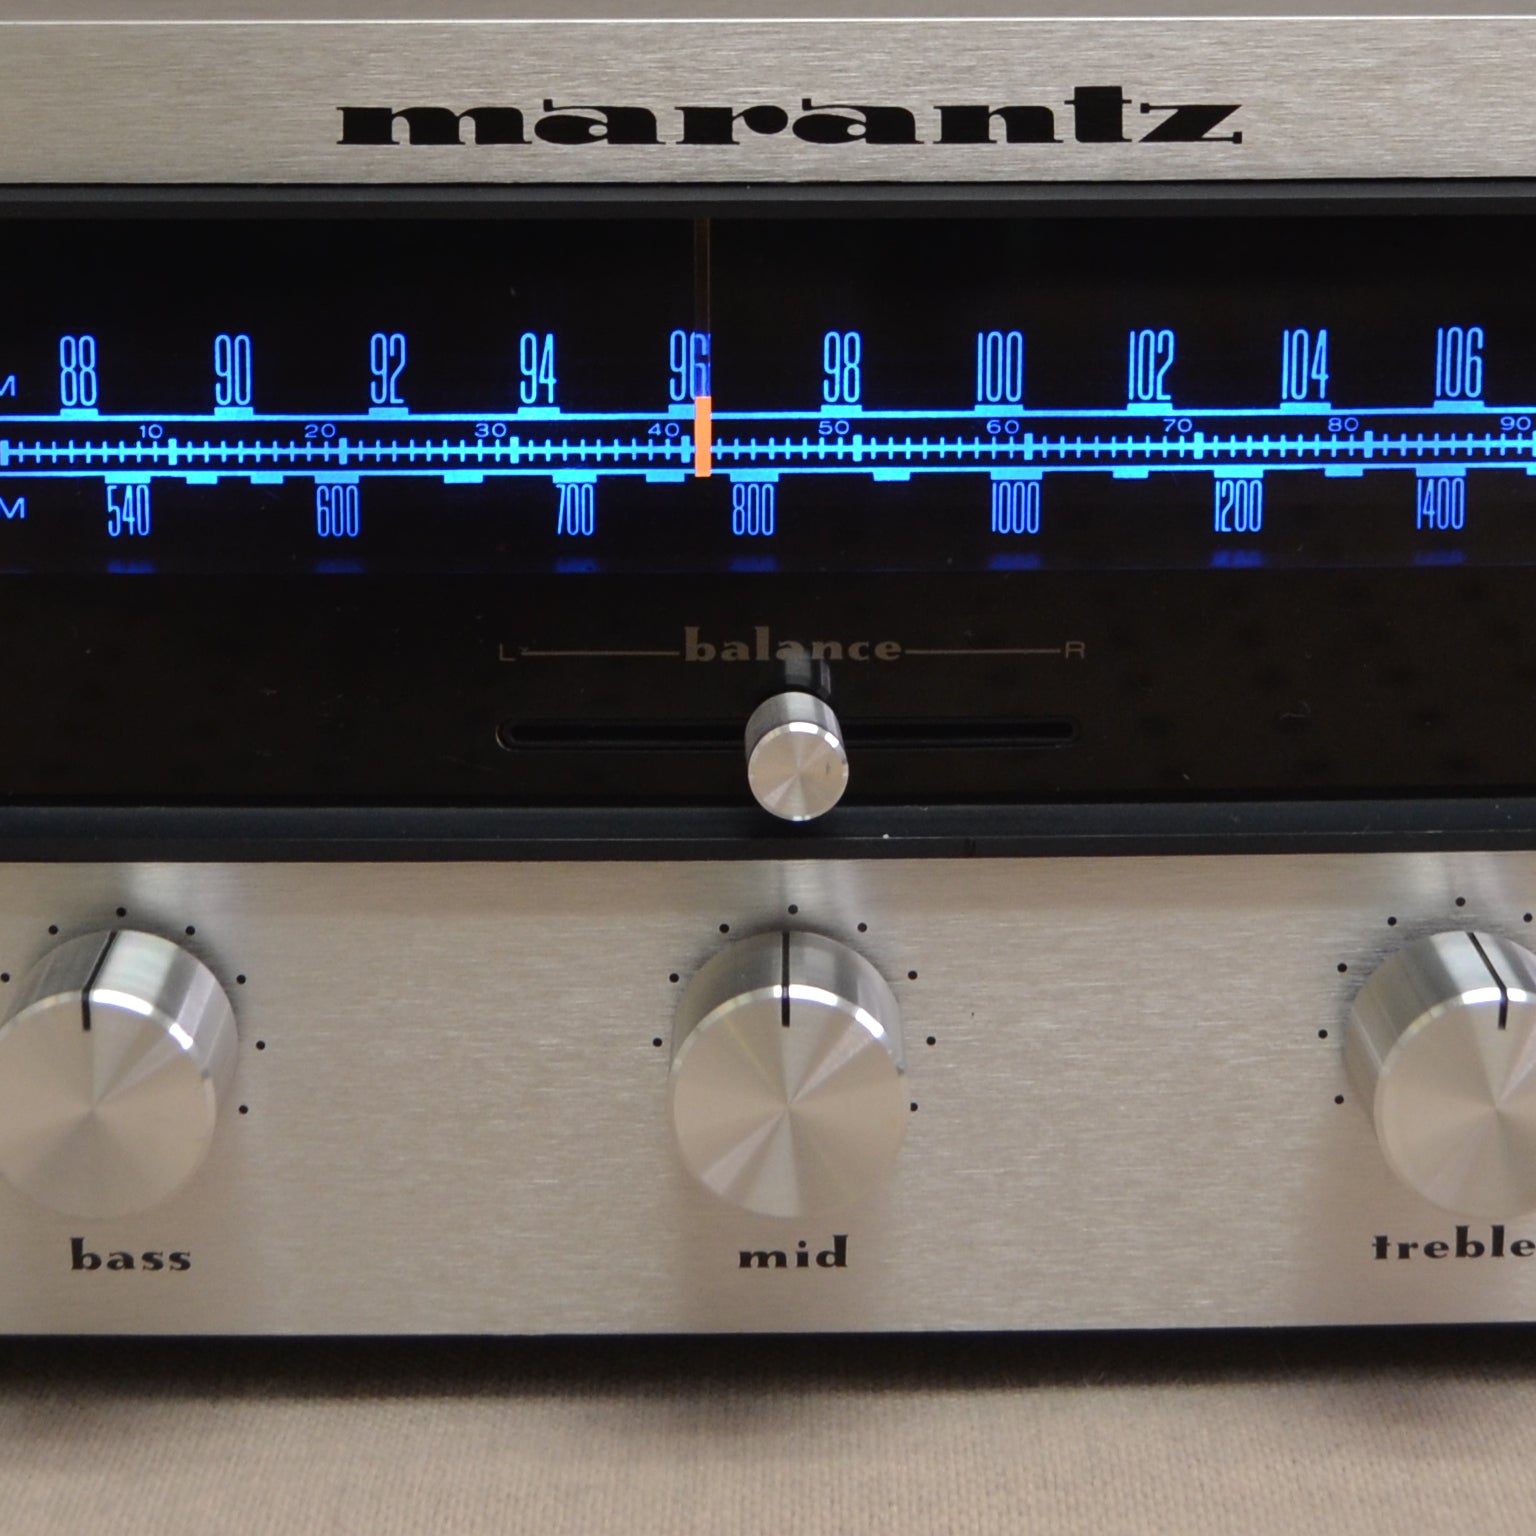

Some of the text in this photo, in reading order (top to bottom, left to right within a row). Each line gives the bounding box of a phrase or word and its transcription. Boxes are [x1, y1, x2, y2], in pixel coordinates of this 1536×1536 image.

[336, 85, 1243, 146] marantz
[60, 335, 96, 407] 88
[214, 334, 251, 406] 90
[370, 333, 406, 405] 92
[520, 332, 556, 404] 94
[669, 330, 711, 401] 96
[823, 331, 860, 402] 98
[977, 331, 1024, 402] 100
[1129, 329, 1174, 401] 102
[1282, 329, 1329, 400] 104
[1435, 326, 1484, 398] 106
[139, 424, 163, 440] 10
[304, 424, 336, 439] 20
[475, 423, 507, 438] 30
[647, 422, 680, 438] 40
[818, 420, 850, 436] 50
[986, 419, 1020, 435] 60
[1163, 417, 1193, 434] 70
[1327, 416, 1359, 433] 80
[1500, 415, 1532, 432] 90
[107, 485, 151, 537] 540
[315, 484, 359, 537] 600
[556, 482, 595, 536] 700
[732, 482, 774, 536] 800
[990, 480, 1040, 534] 1000
[1214, 479, 1263, 532] 1200
[1416, 477, 1465, 530] 1400
[498, 626, 1085, 663] L balance R
[70, 1237, 191, 1272] bass
[738, 1235, 848, 1269] mid
[1372, 1225, 1536, 1260] treble
